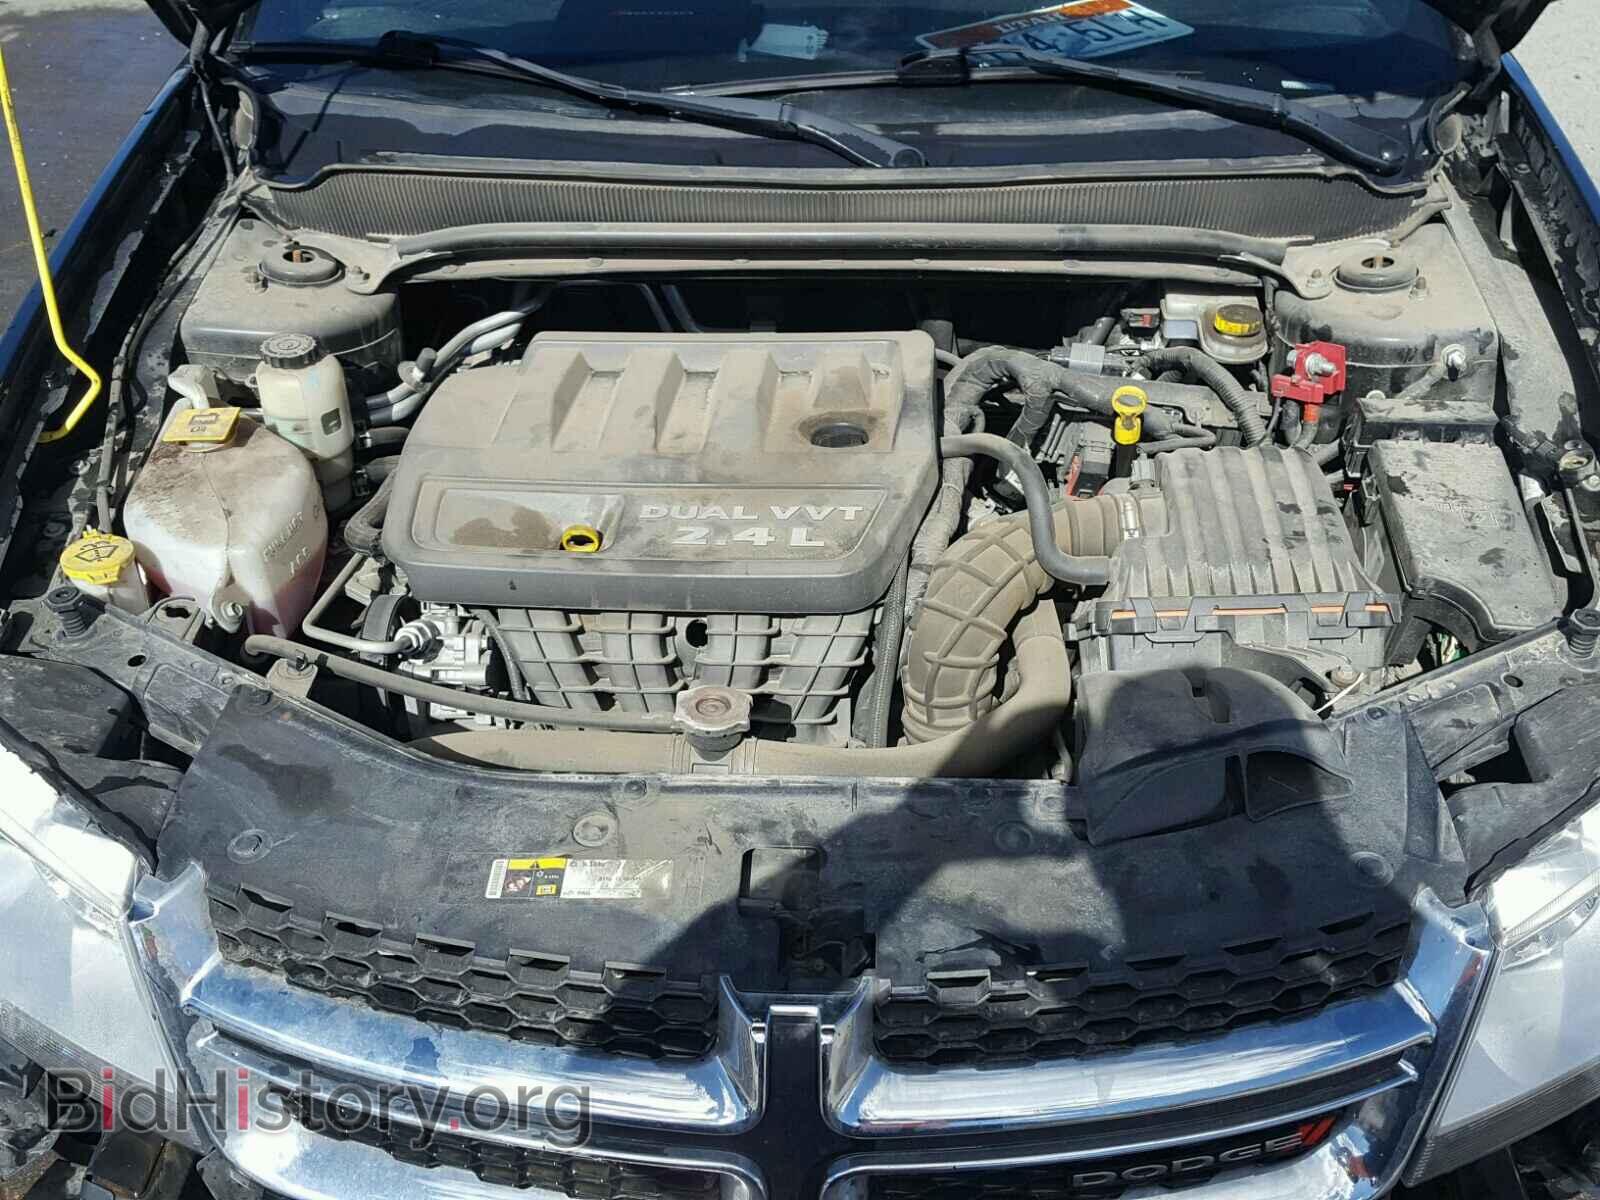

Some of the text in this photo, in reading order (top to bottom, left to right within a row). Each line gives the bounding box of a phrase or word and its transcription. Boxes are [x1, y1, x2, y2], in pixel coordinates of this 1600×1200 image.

[992, 12, 1065, 33] UTAH
[639, 503, 865, 521] DUAL VVT
[1072, 1131, 1302, 1188] DODGE
